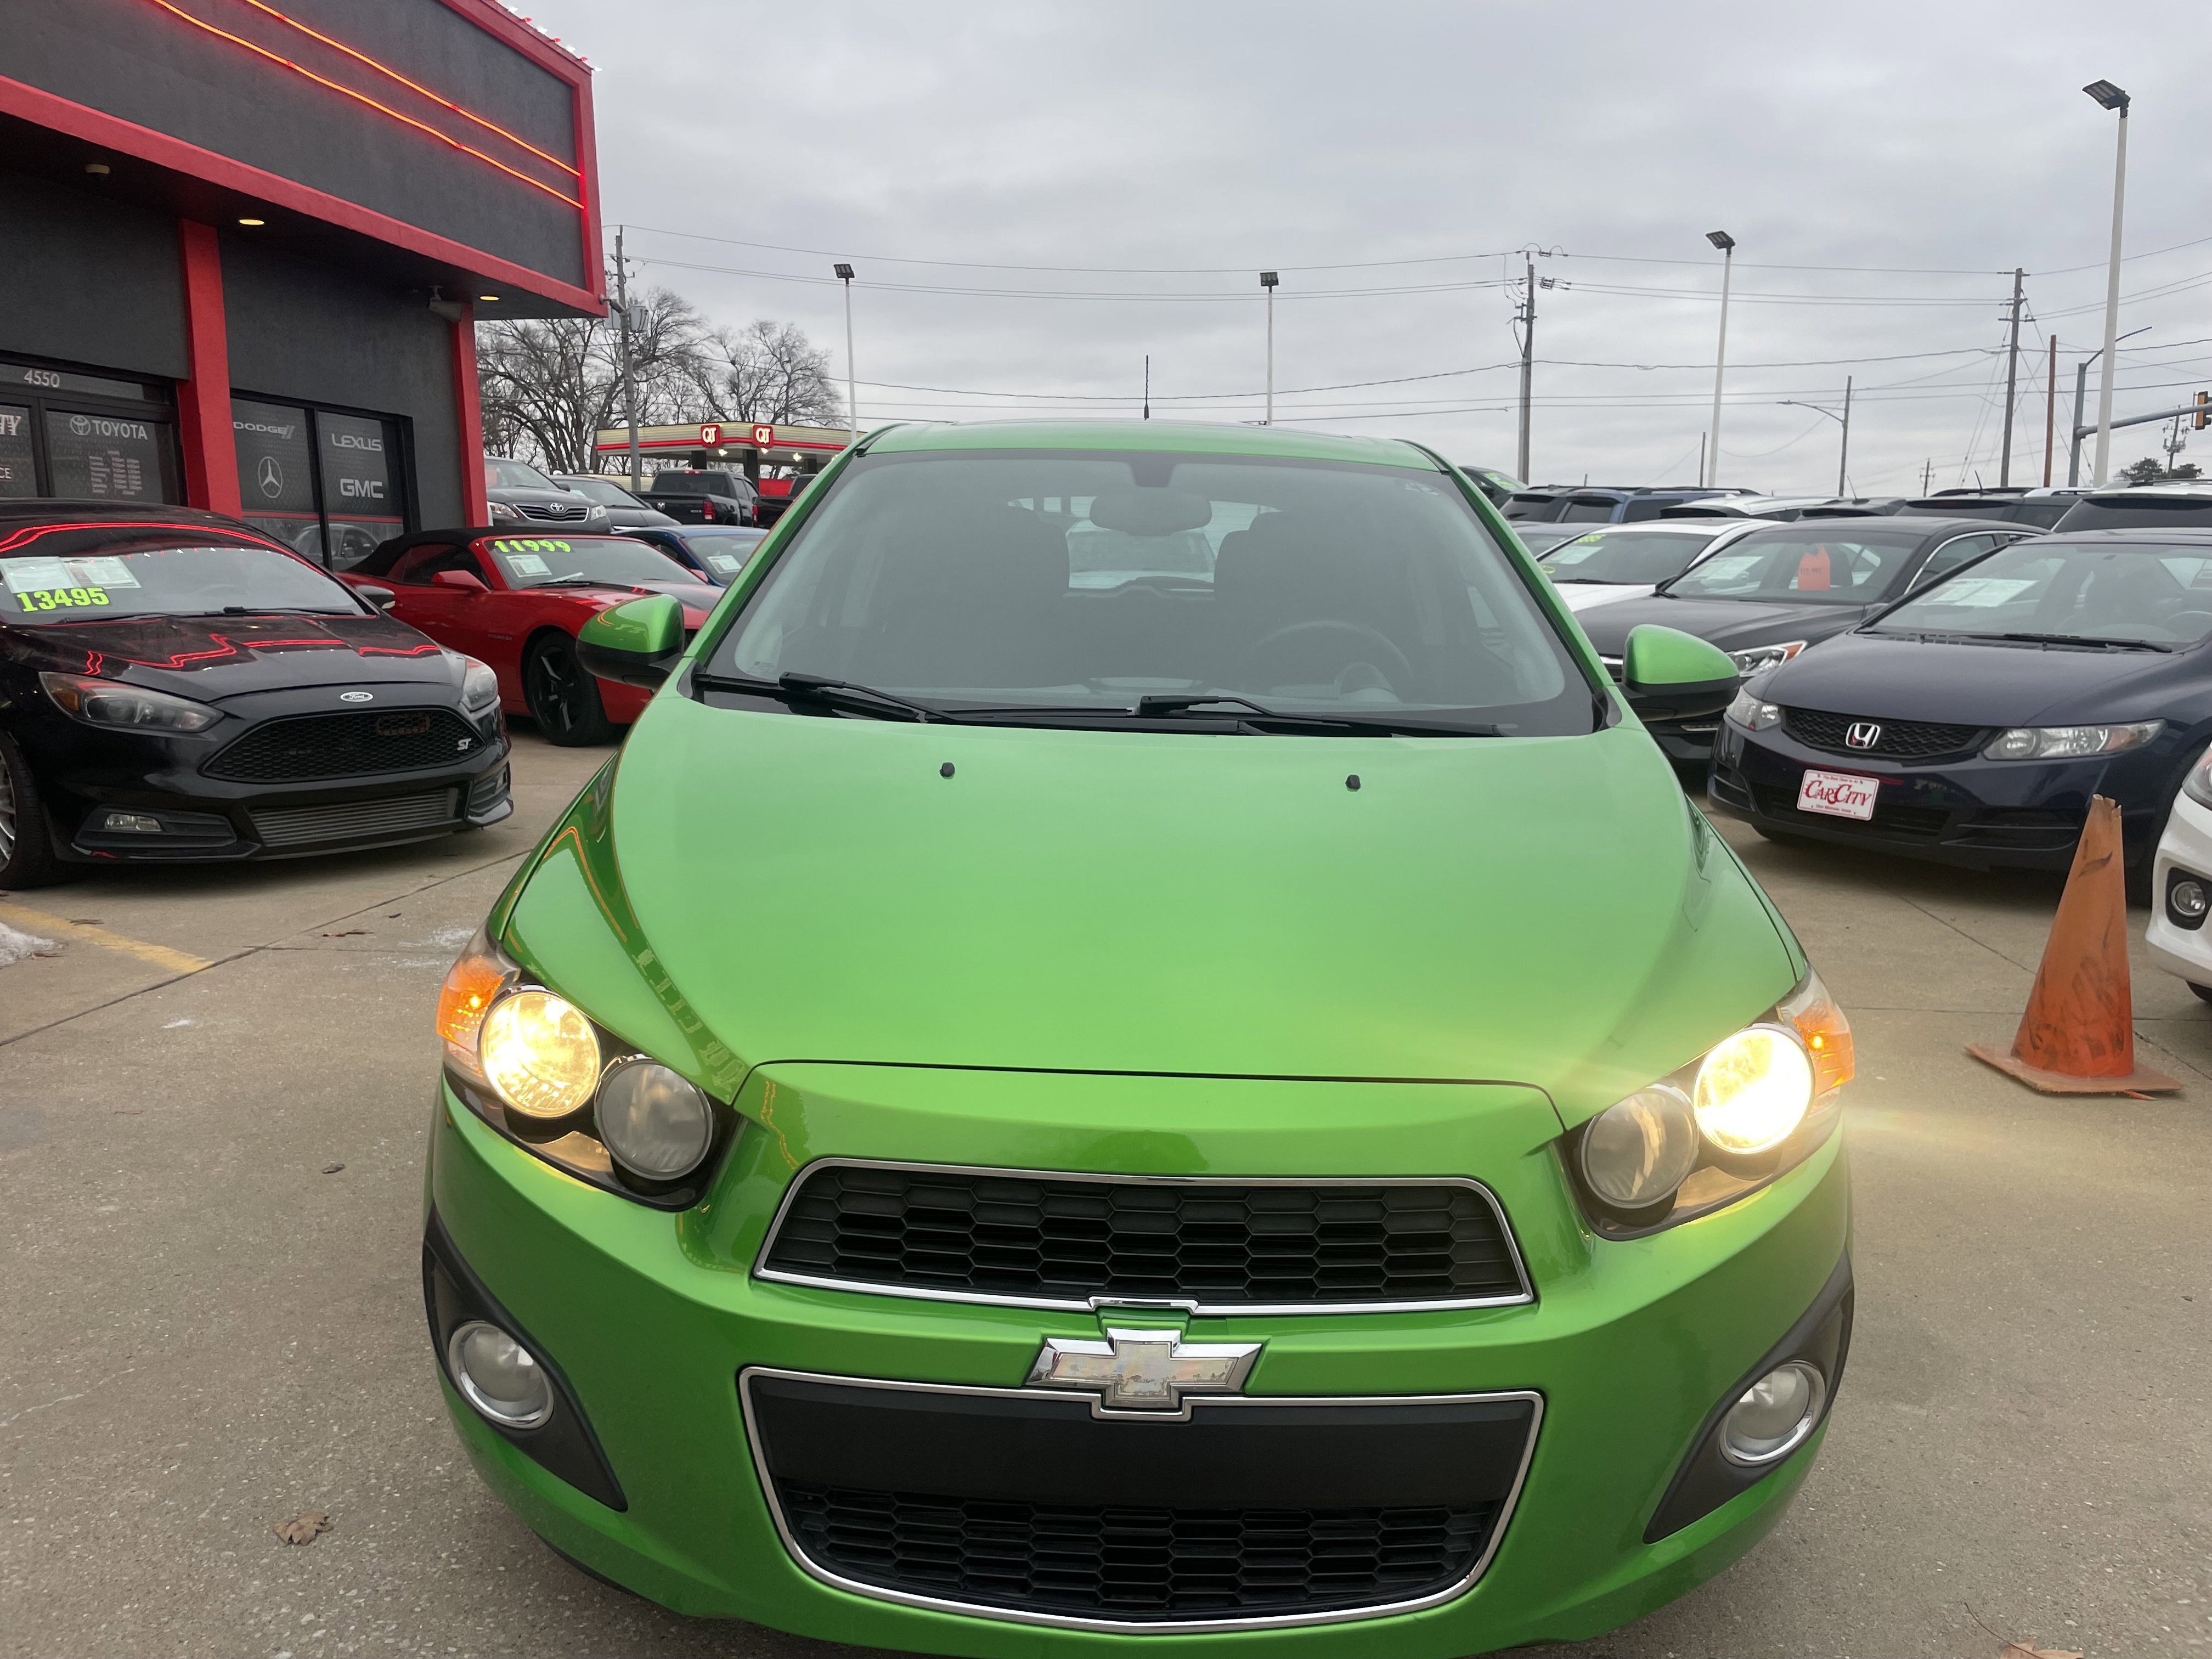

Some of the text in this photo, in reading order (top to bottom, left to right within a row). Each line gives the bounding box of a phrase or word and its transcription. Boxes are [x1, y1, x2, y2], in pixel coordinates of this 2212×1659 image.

[24, 369, 60, 388] 4550
[91, 420, 148, 440] TOYOTA
[233, 421, 287, 435] DODGE
[702, 427, 716, 444] QT
[755, 427, 771, 444] QT
[331, 433, 382, 452] LEXUS
[340, 478, 383, 499] GMC
[494, 539, 571, 552] 11999
[17, 588, 109, 612] 13495
[457, 737, 472, 751] ST
